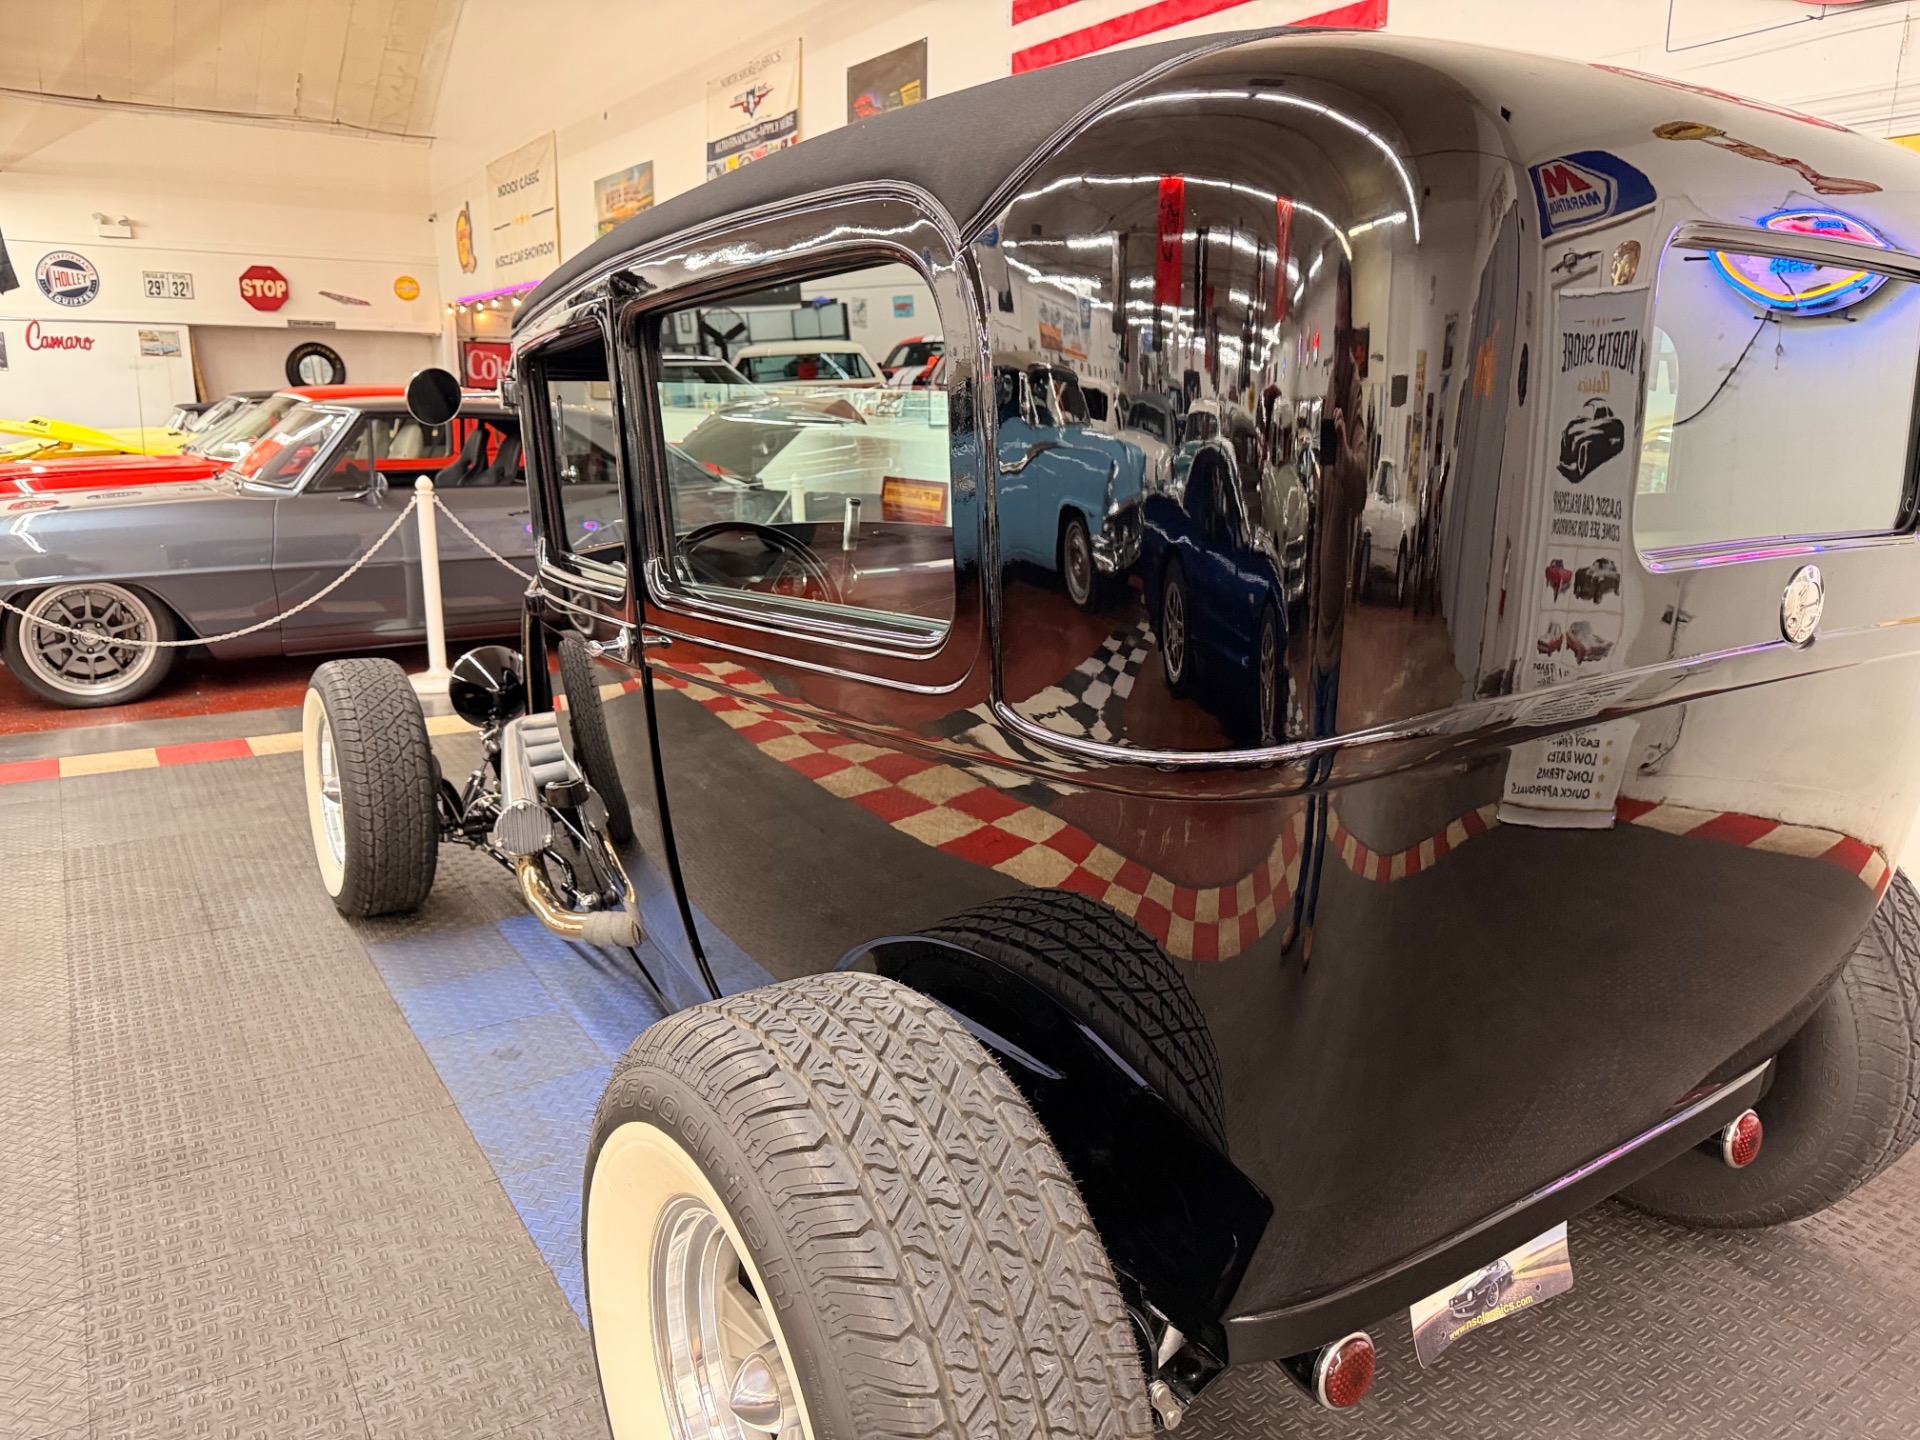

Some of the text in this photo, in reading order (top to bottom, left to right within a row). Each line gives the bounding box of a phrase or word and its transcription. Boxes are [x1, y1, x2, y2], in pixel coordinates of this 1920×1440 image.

[53, 270, 87, 288] HOLLEY
[241, 278, 287, 298] STOP
[25, 319, 95, 351] Camaro
[1449, 1295, 1533, 1340] www.nsclassics.com
